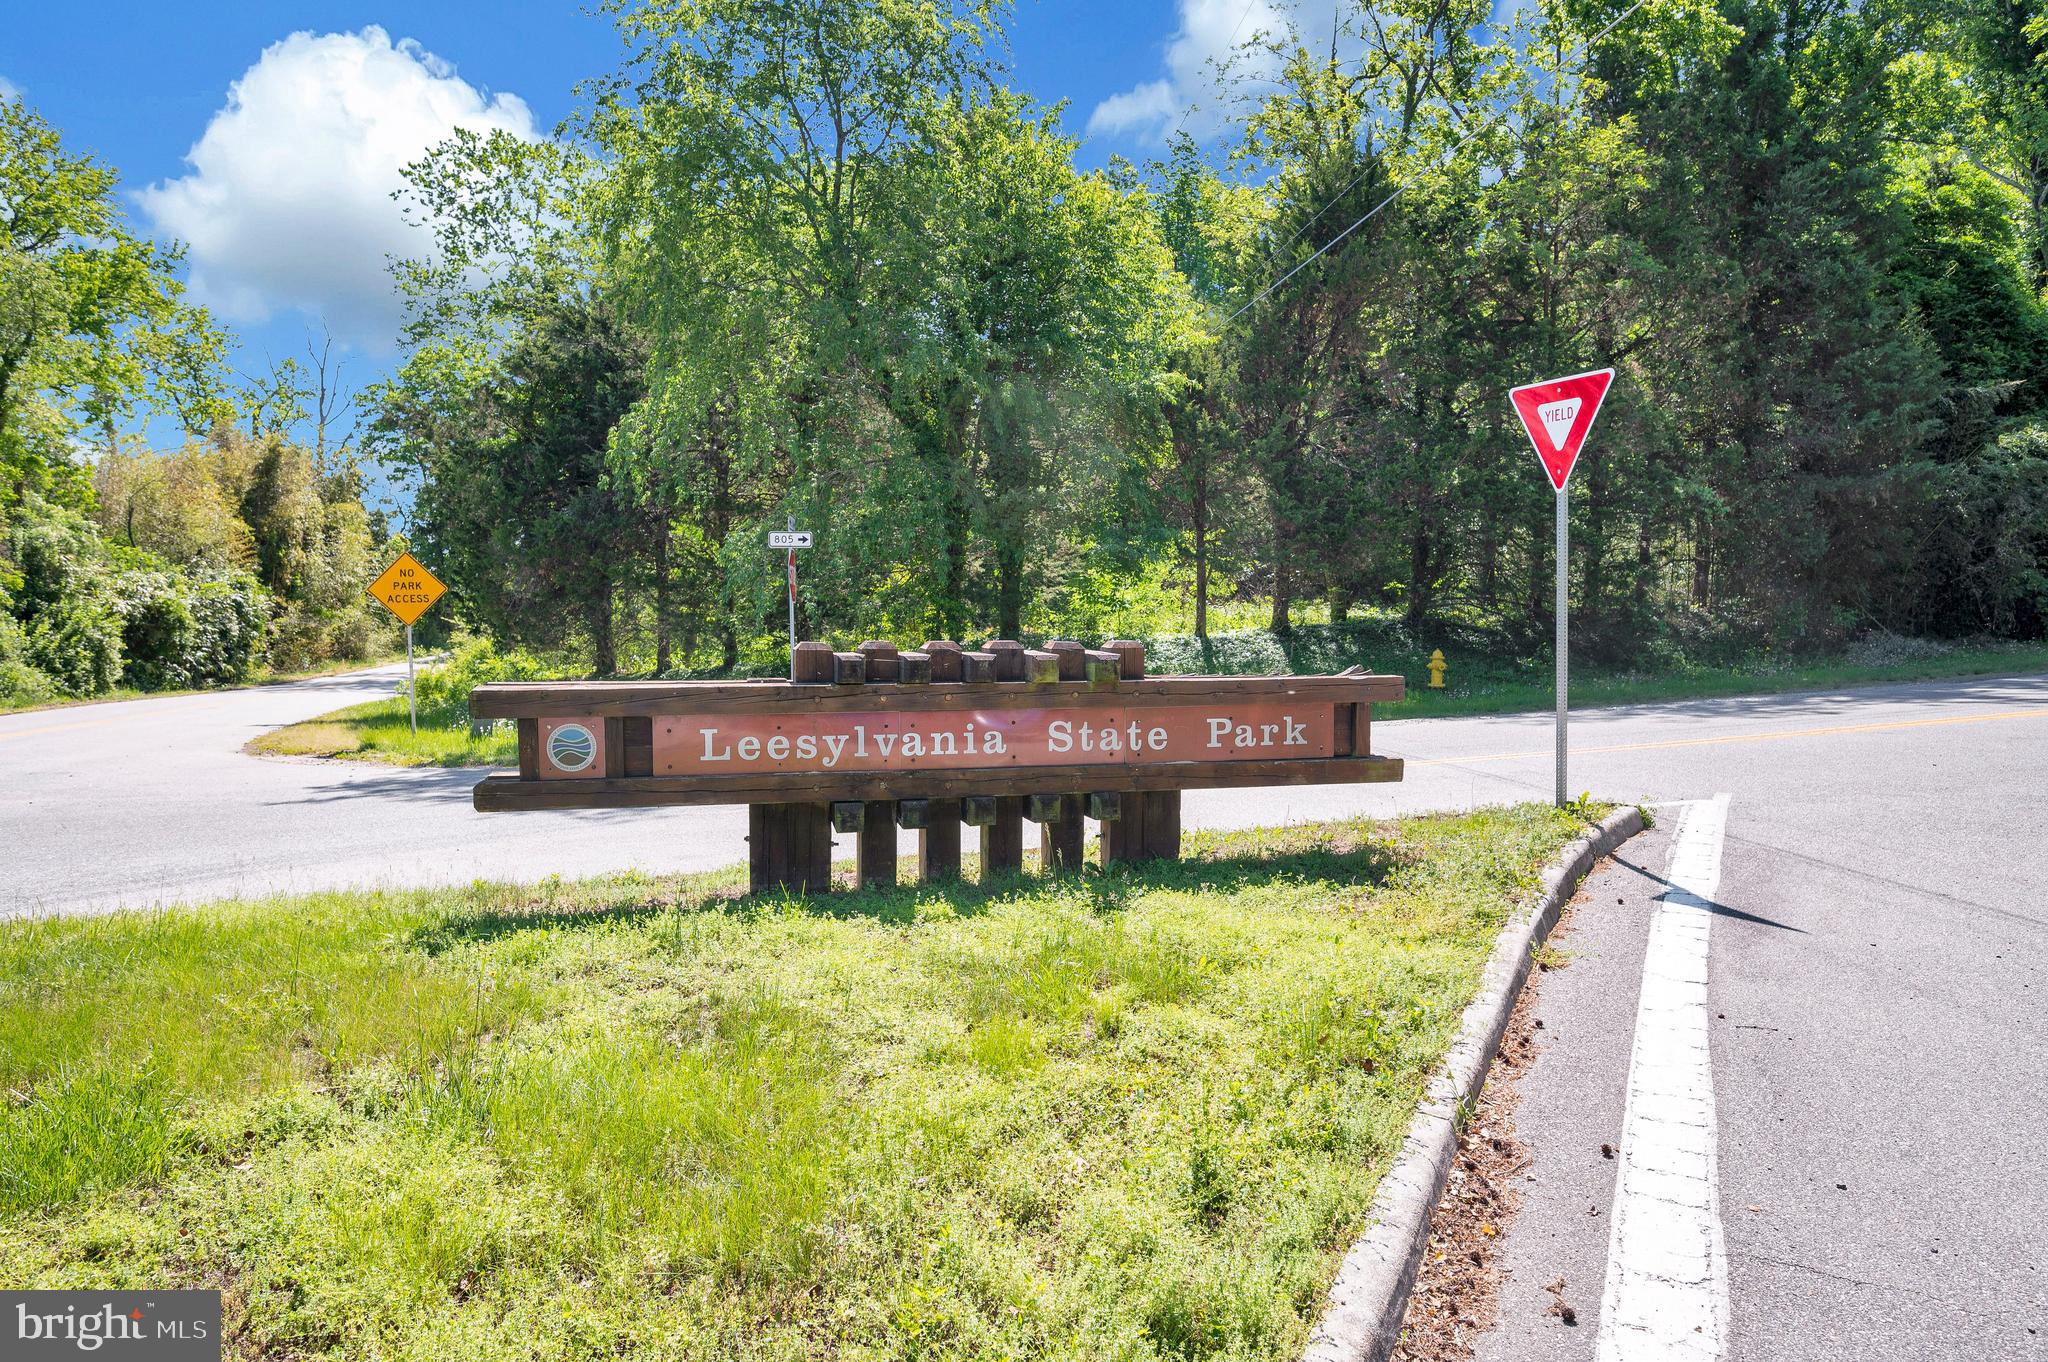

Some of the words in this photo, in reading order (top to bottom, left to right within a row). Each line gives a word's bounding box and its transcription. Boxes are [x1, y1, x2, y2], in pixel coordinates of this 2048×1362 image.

[1545, 406, 1574, 423] YIELD
[774, 535, 794, 544] 805
[399, 568, 415, 578] NO
[393, 581, 422, 590] PARK
[387, 594, 430, 603] ACCESS
[700, 722, 1007, 768] Leesylvania
[1048, 719, 1169, 753] State
[1206, 716, 1308, 749] Park
